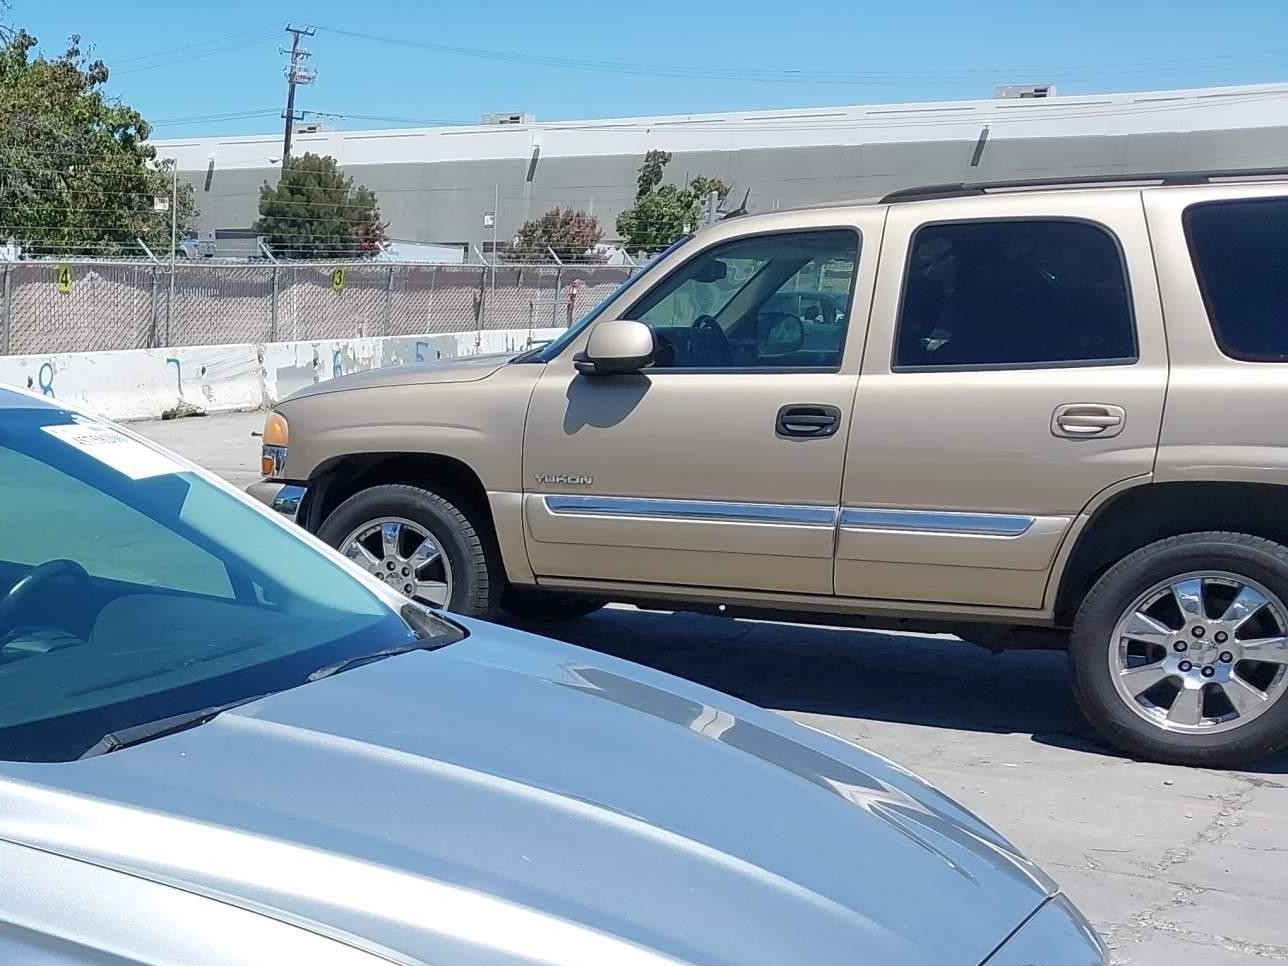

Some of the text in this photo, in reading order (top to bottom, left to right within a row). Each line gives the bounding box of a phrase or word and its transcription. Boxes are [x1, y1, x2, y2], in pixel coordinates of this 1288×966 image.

[60, 268, 69, 287] 4
[334, 269, 343, 286] 3
[38, 362, 56, 399] 8
[166, 357, 185, 397] 7
[535, 472, 593, 485] YUKON
